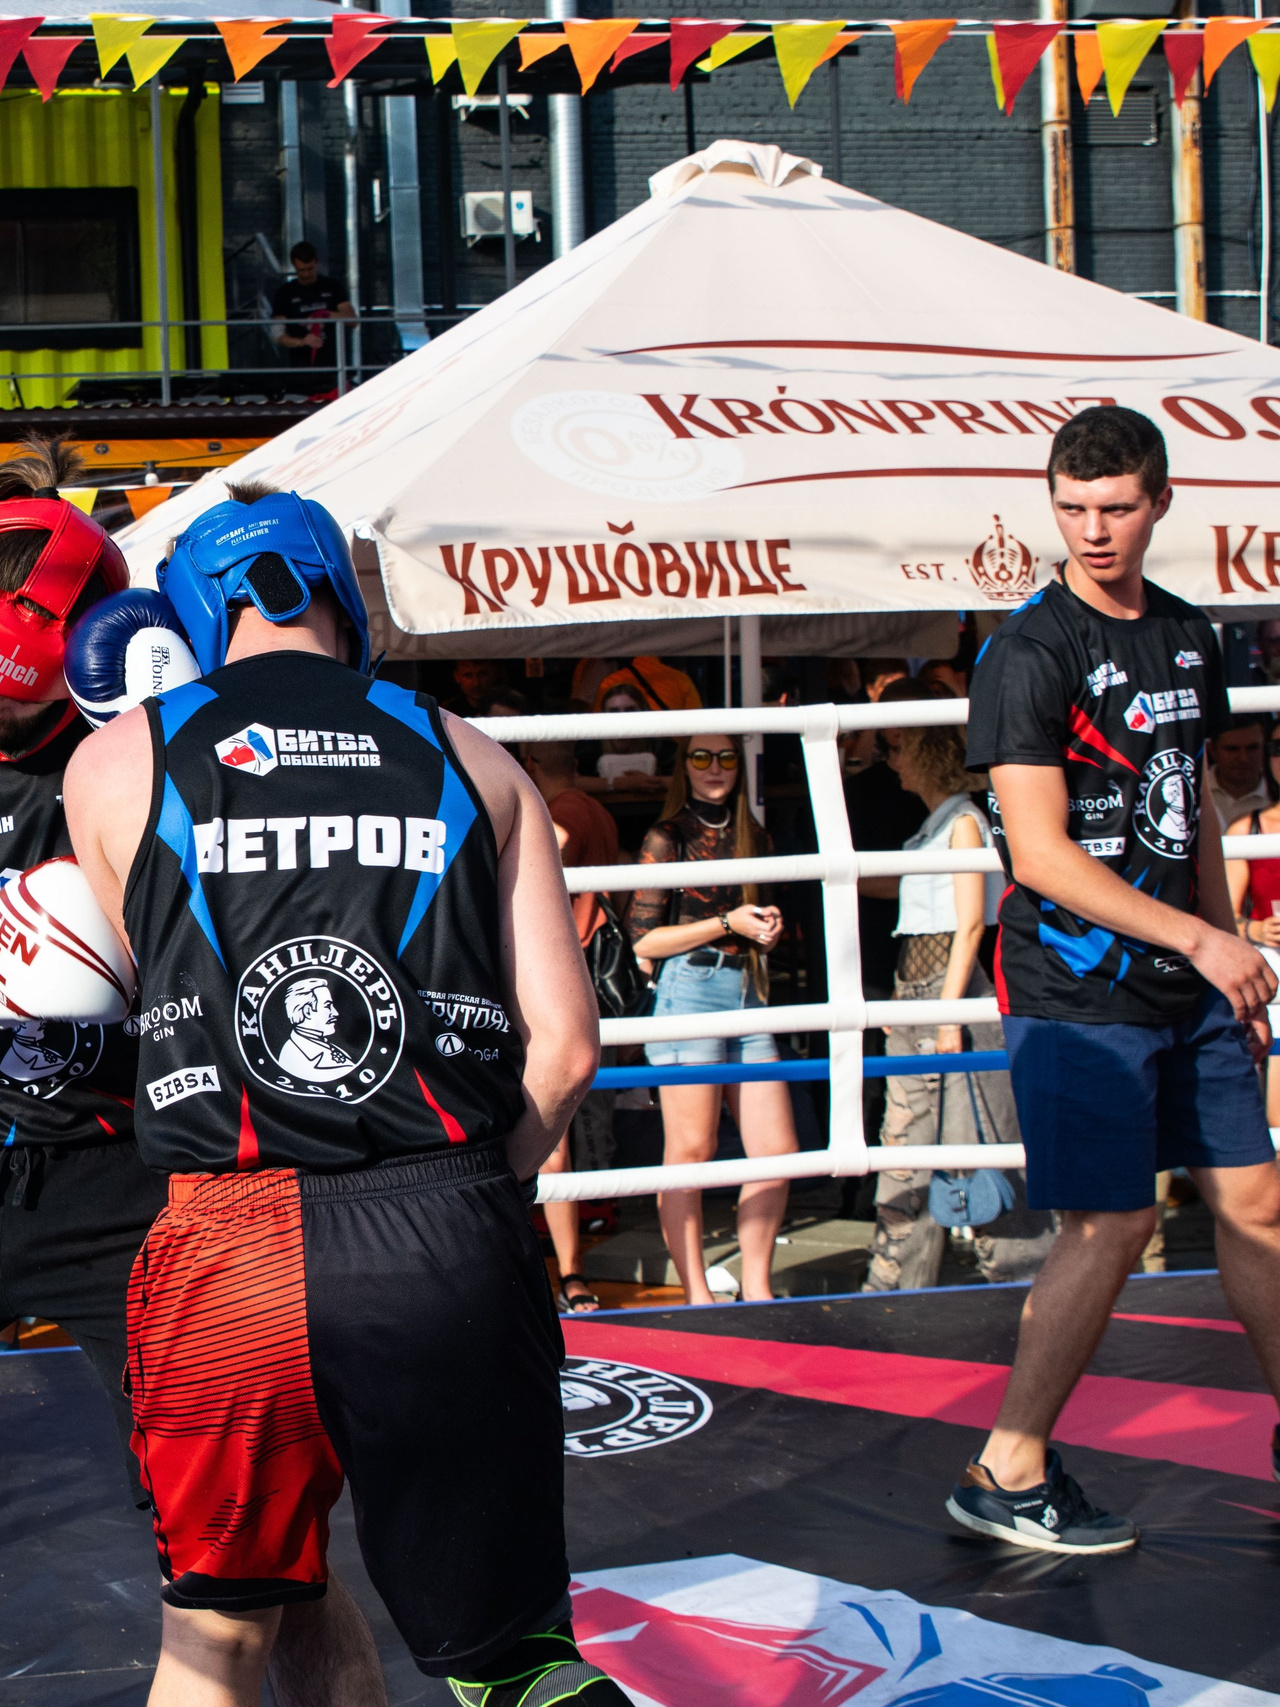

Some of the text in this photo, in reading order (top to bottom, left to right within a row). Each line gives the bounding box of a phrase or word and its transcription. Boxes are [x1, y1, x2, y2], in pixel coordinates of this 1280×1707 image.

[638, 385, 1116, 440] KRÓNPRIN
[230, 526, 246, 538] SAFE
[258, 518, 279, 528] SWEAT
[242, 527, 270, 541] LEATHER
[900, 562, 958, 582] EST.
[277, 729, 379, 752] БИТВА
[280, 753, 381, 767] ОБЩЕПИТОВ
[1084, 812, 1105, 821] GIN
[192, 814, 447, 875] ВЕТРОВ
[1083, 839, 1124, 853] IBSA
[241, 943, 398, 1038] КАНЦЛЕРЪ
[417, 989, 446, 1000] ПЕРВАЯ
[447, 993, 480, 1005] РУССКАЯ
[140, 995, 204, 1037] BROOM
[153, 1025, 175, 1042] GIN
[153, 1071, 215, 1103] SIBSA
[276, 1068, 376, 1099] 2010
